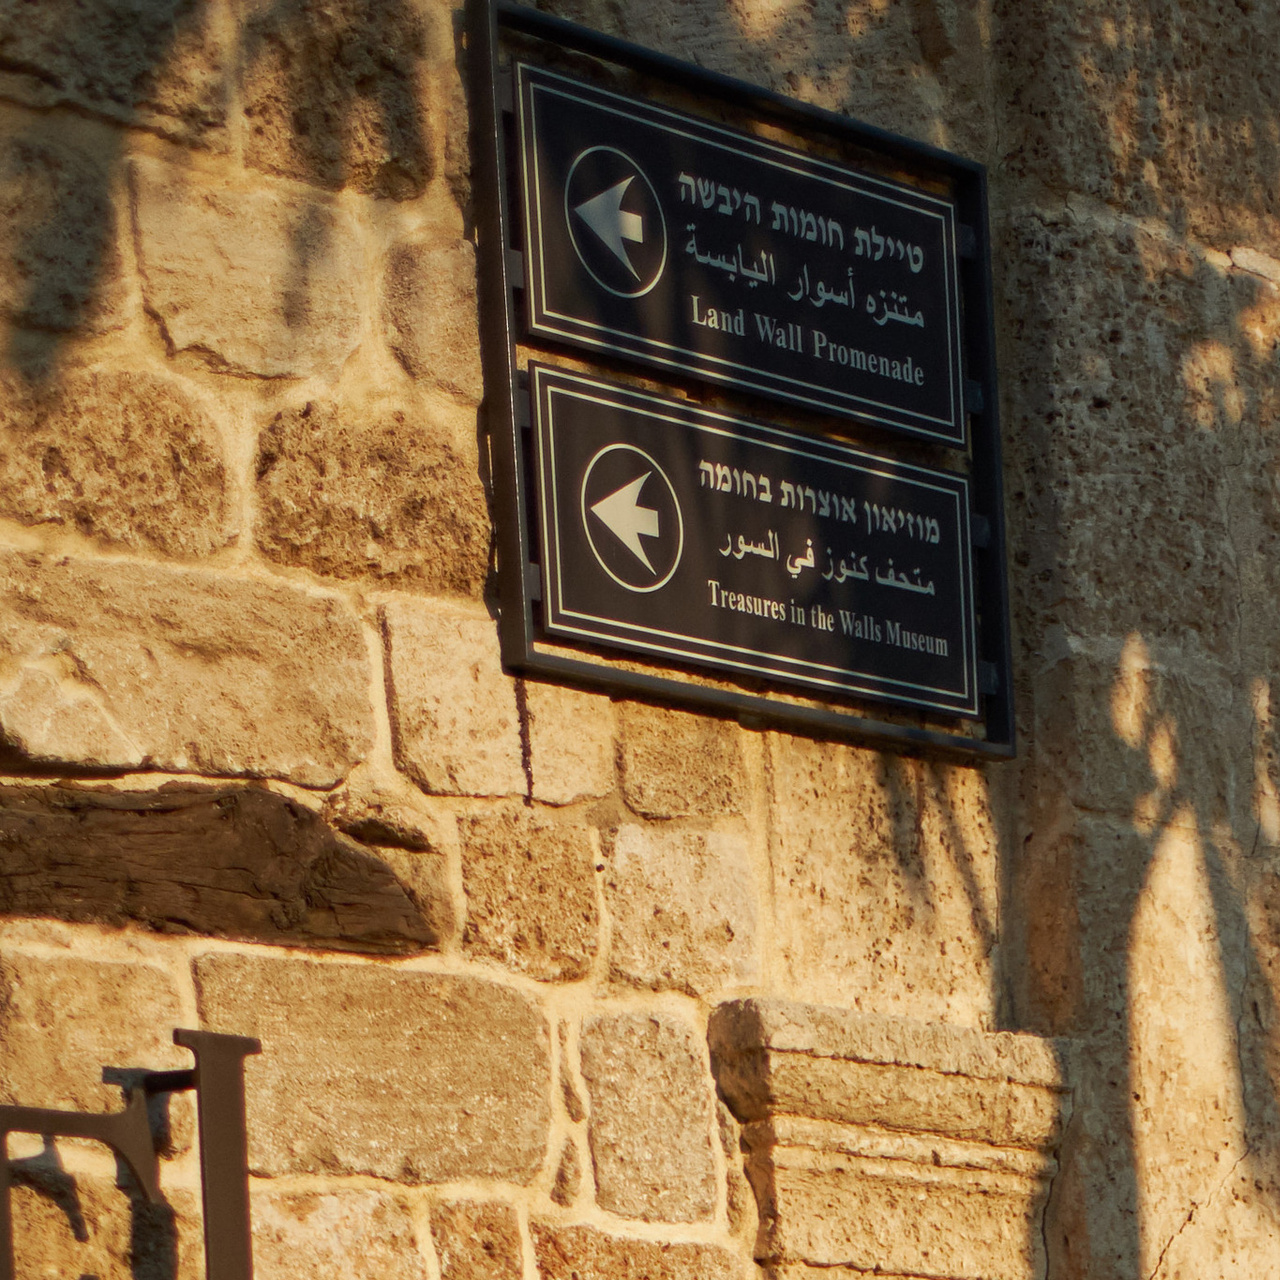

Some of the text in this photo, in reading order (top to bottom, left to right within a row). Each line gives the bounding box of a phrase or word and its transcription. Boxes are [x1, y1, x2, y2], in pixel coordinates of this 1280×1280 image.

[677, 170, 924, 274] טיילת חומות היבשה
[684, 222, 925, 328] متنزه أسوار اليابسة
[690, 294, 925, 386] Land Wall Promenade
[698, 458, 941, 544] מוזיאון אוצרות בחומה
[718, 528, 936, 596] متحف كنوز في السور
[707, 579, 949, 657] Treasures in the Walls Museum
